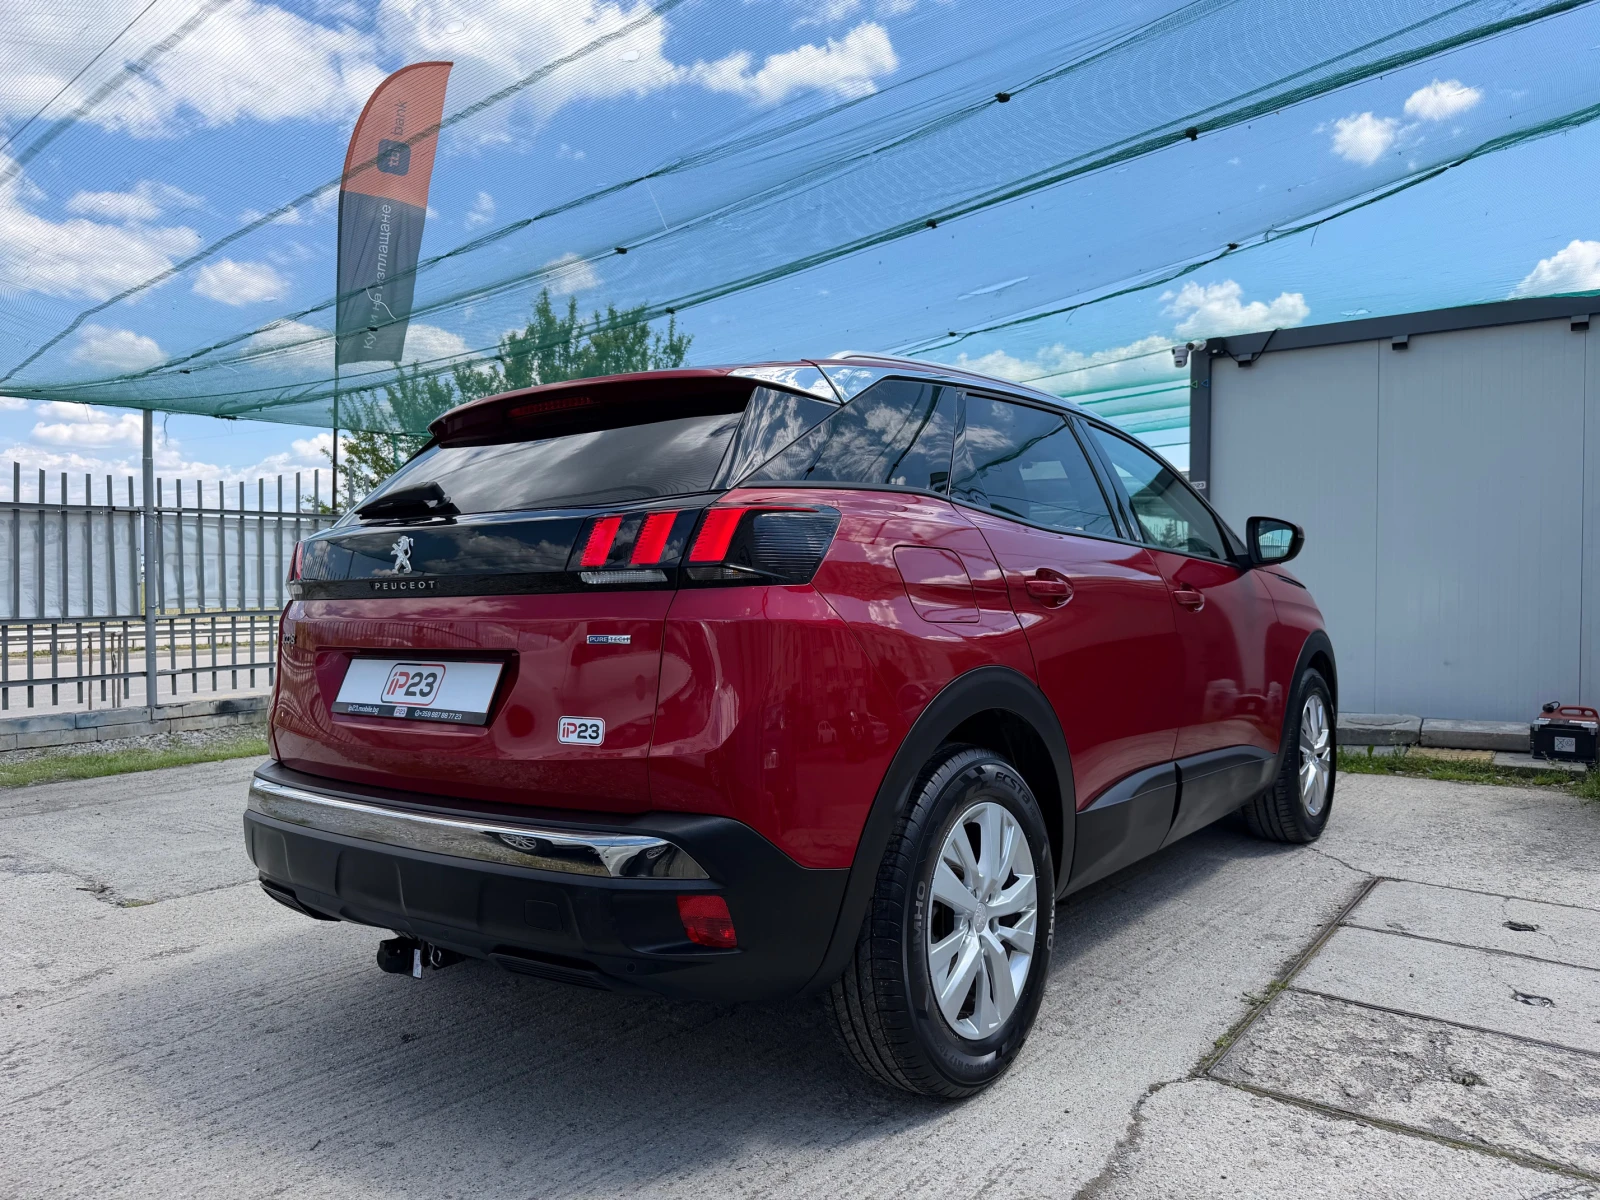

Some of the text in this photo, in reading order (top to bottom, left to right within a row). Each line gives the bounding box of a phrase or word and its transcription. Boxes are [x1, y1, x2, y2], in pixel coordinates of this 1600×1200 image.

[390, 99, 408, 137] bank
[371, 293, 383, 312] на
[374, 581, 435, 590] PEUGEOT
[347, 704, 380, 715] ip23.mobile.bg
